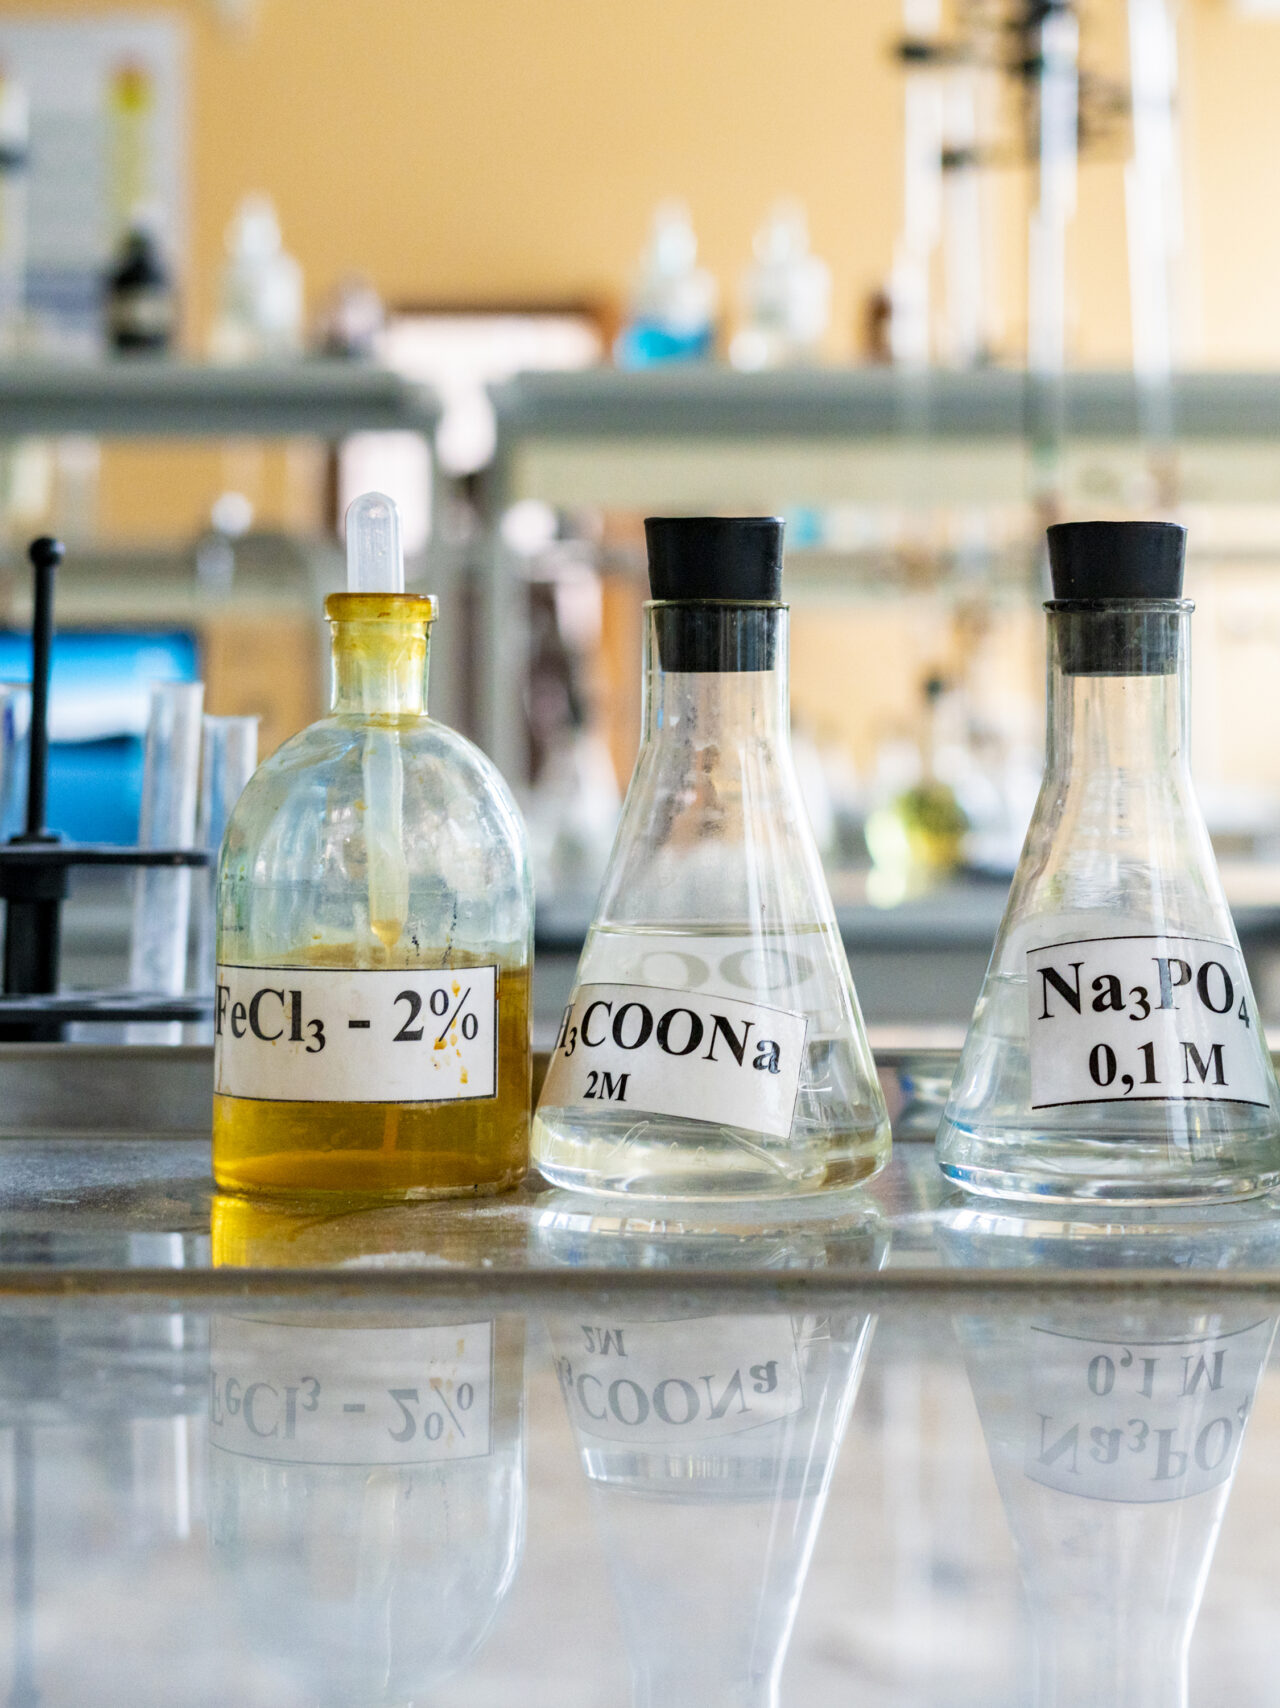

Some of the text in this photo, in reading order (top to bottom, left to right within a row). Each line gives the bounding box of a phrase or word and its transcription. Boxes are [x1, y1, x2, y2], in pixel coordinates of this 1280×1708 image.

[216, 984, 327, 1053] FeCl3
[392, 986, 480, 1043] 2%
[1036, 957, 1251, 1029] Na3PO4
[583, 1070, 632, 1102] 2M
[1088, 1041, 1230, 1094] 0,1 M
